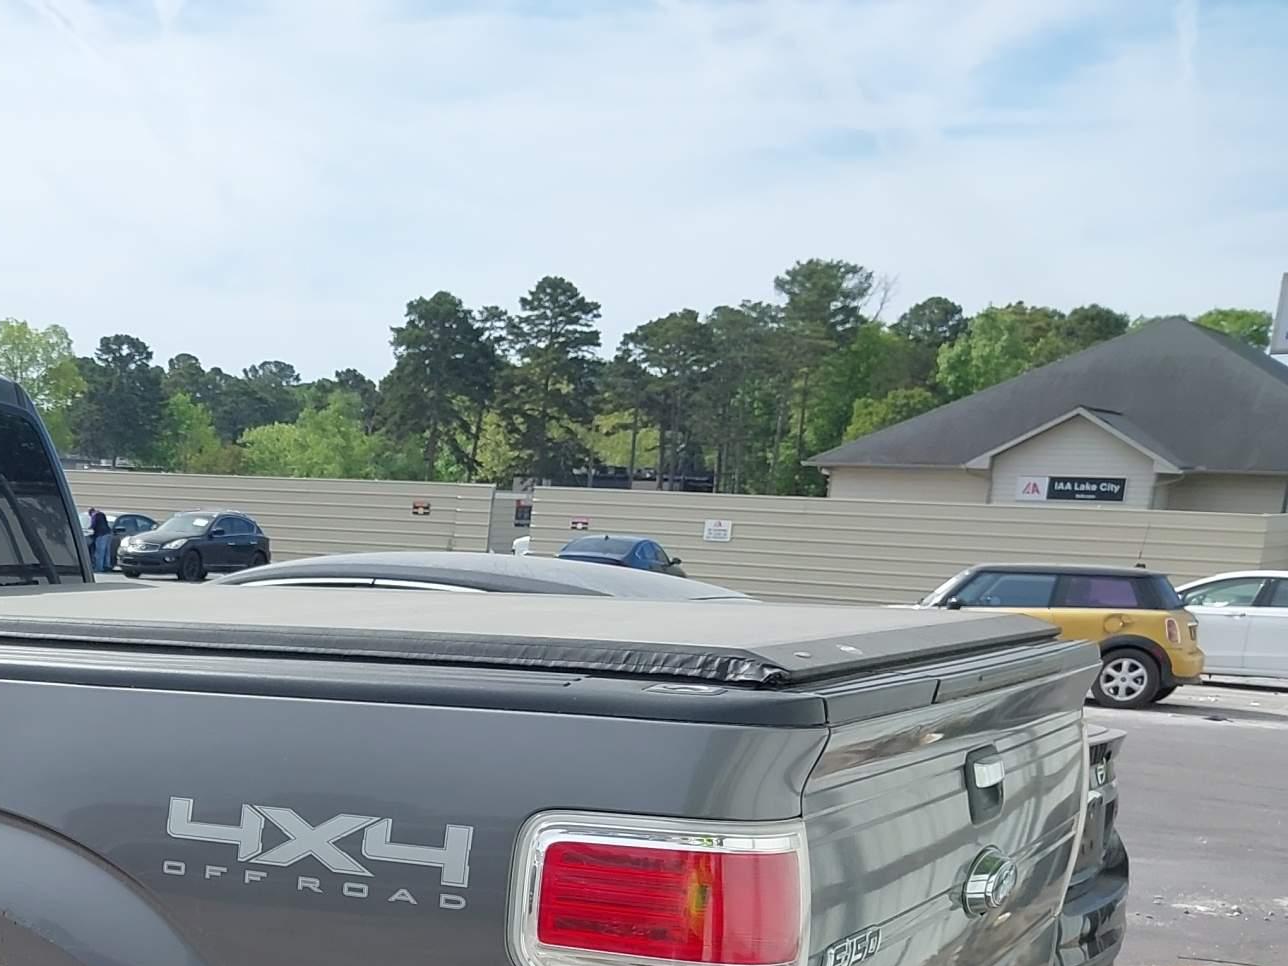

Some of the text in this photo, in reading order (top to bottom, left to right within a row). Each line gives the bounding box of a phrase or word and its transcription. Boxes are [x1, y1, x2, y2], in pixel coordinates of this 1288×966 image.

[1054, 481, 1121, 494] IAA Lake City
